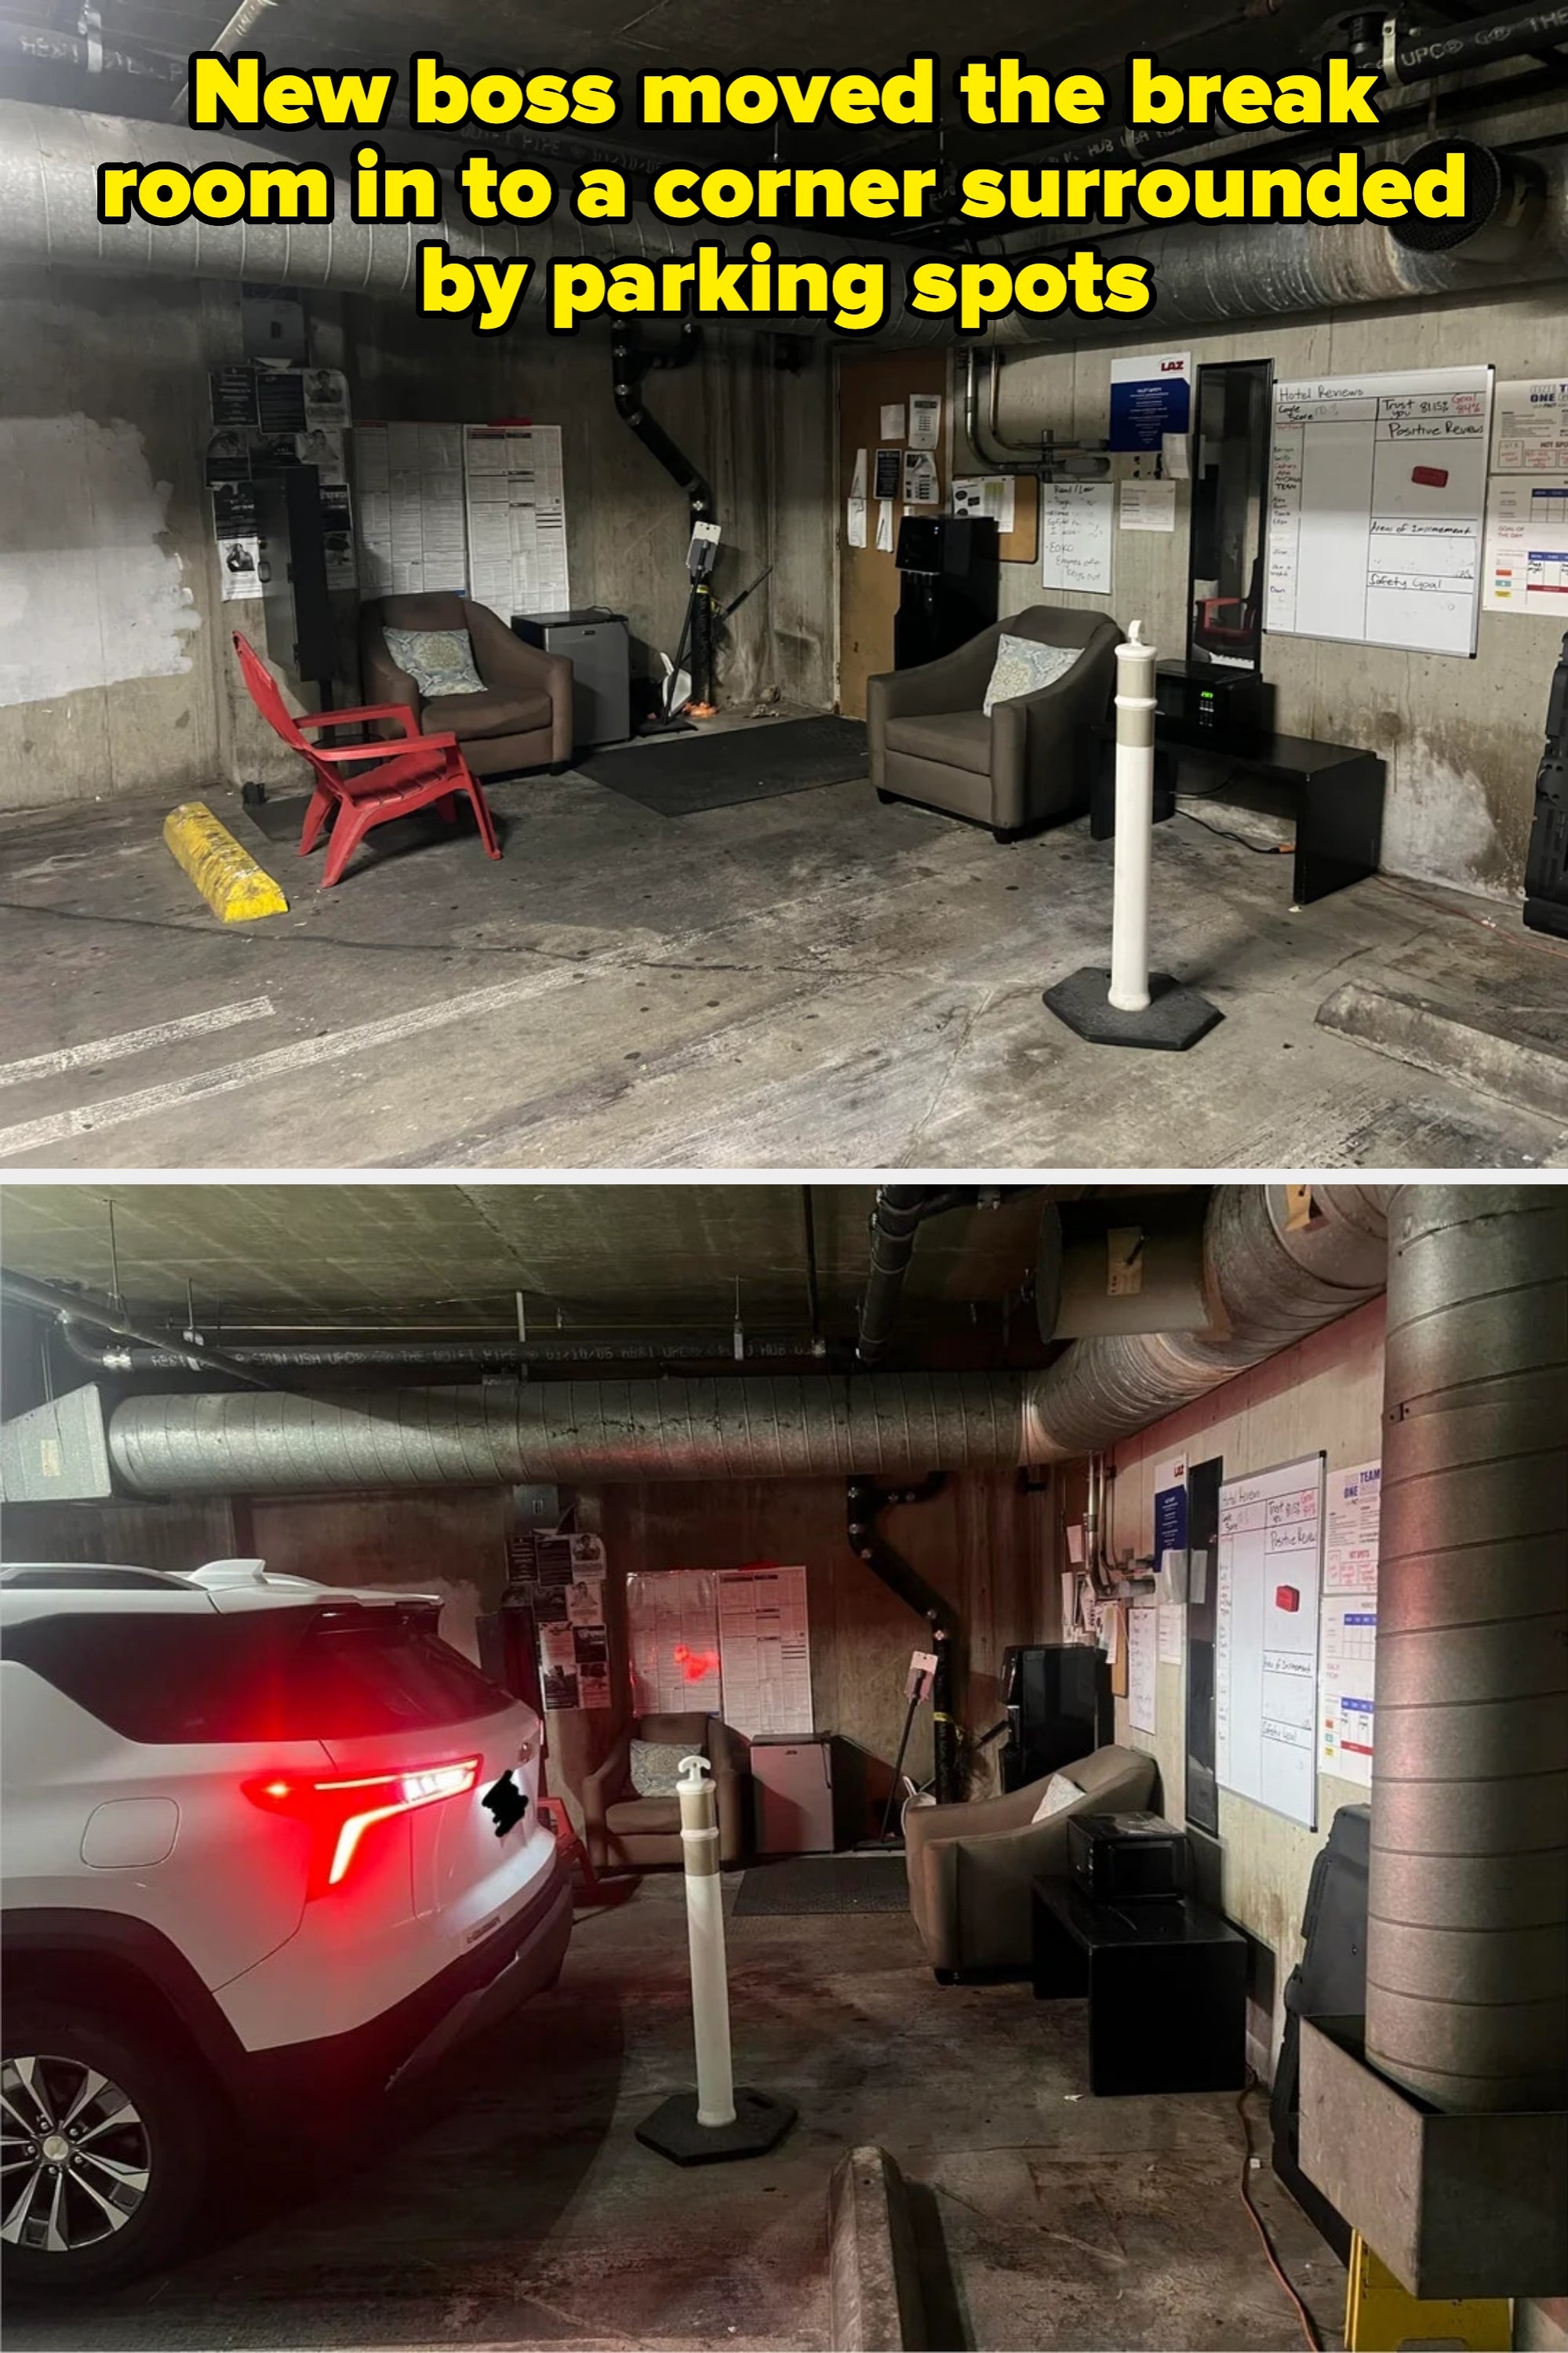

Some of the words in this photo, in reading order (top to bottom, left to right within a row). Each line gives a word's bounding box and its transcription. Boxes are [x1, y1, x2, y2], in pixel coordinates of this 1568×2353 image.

[1161, 361, 1184, 371] LAZ
[1279, 387, 1312, 401] Hotel
[1318, 384, 1364, 398] Reviews
[1530, 393, 1555, 403] ONE
[1382, 398, 1413, 410] Trust
[1391, 409, 1411, 420] you
[1388, 422, 1440, 439] Positive
[1370, 573, 1407, 590] Safety
[1413, 576, 1442, 591] Goal
[1360, 1468, 1381, 1484] TEAM
[1344, 1486, 1359, 1499] ONE
